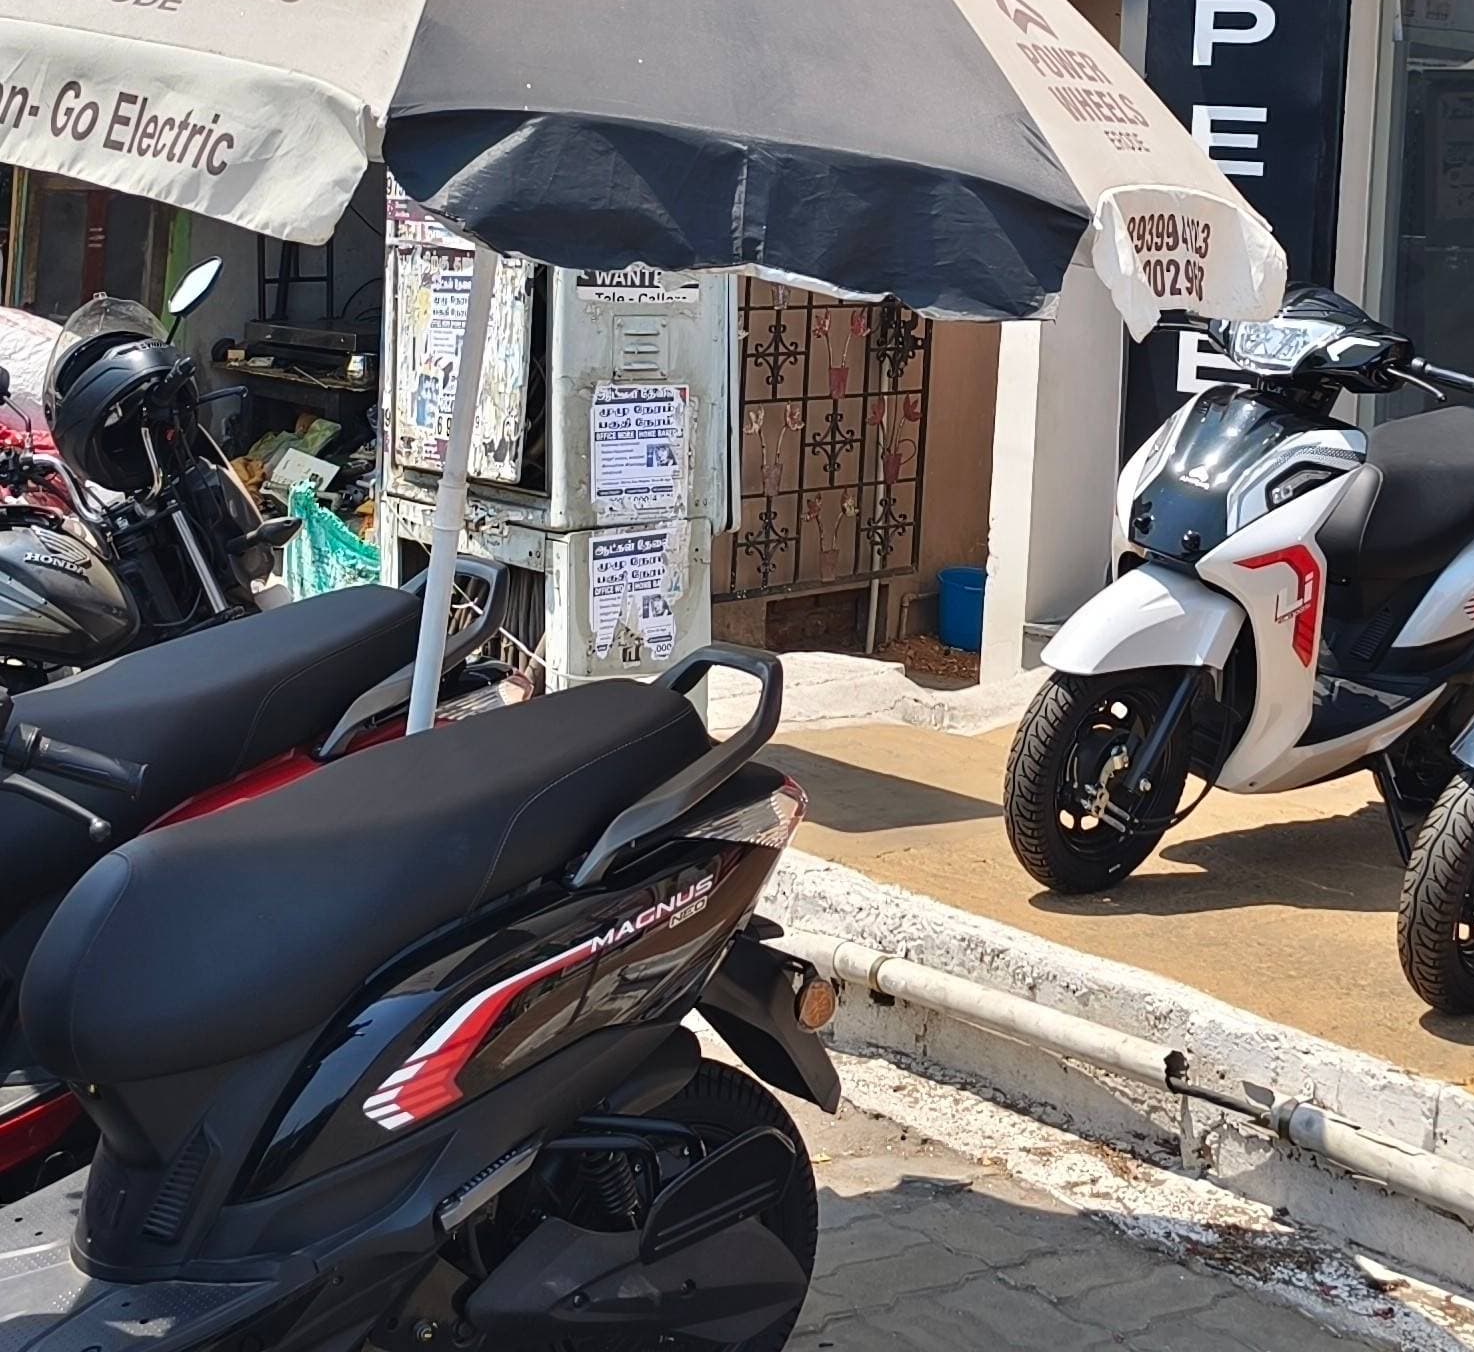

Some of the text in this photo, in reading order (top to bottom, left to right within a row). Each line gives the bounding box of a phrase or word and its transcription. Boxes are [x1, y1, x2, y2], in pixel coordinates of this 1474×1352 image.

[1016, 42, 1113, 86] POWER
[50, 80, 100, 142] Go
[102, 91, 236, 177] Electric
[1047, 85, 1150, 128] WHEELS
[590, 873, 714, 954] MAGNUS
[671, 898, 706, 926] NEO
